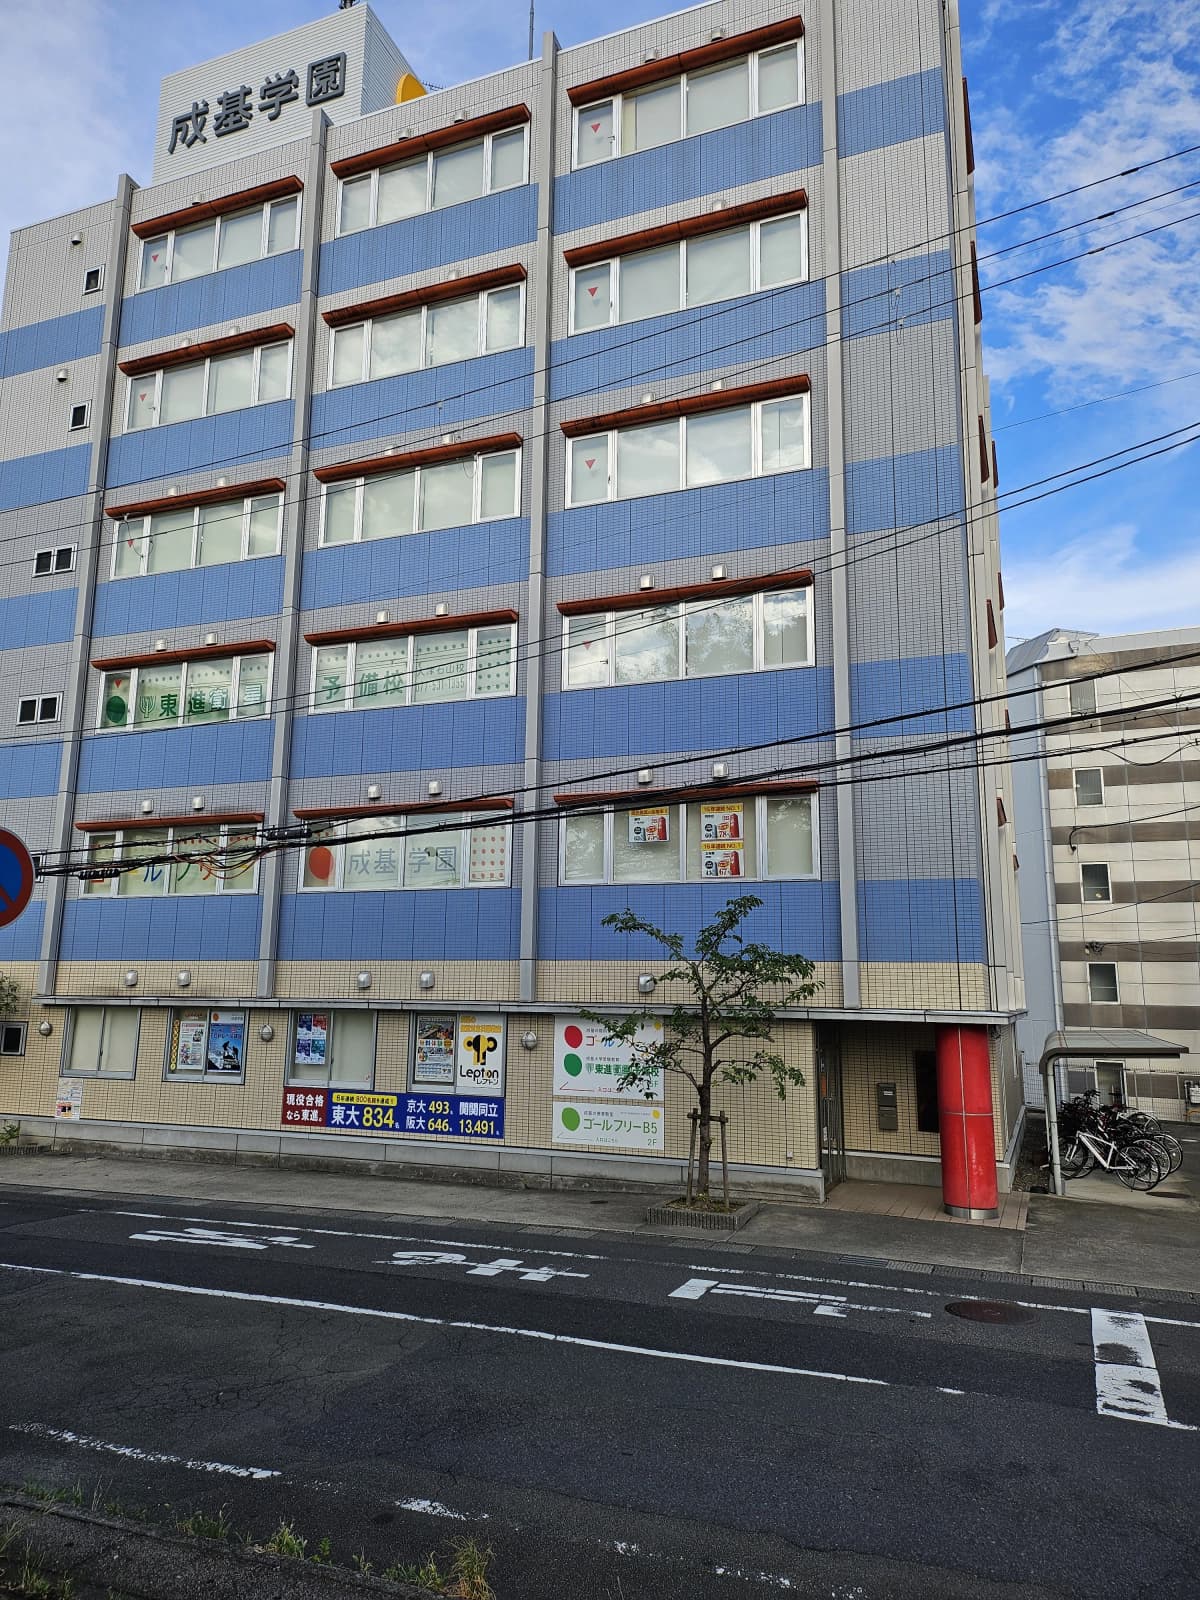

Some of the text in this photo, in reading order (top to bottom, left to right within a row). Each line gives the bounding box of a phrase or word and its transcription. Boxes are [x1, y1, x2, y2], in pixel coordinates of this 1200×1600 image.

[168, 51, 347, 154] 成基学園
[349, 846, 457, 875] 成基学園
[460, 1065, 499, 1081] Lepton
[286, 1093, 324, 1107] 現役合格
[406, 1099, 427, 1113] 京大
[331, 1104, 360, 1126] 東大
[459, 1101, 498, 1117] 関関同立
[406, 1116, 426, 1130] 阪大
[584, 1118, 658, 1134] ゴールフリーB5
